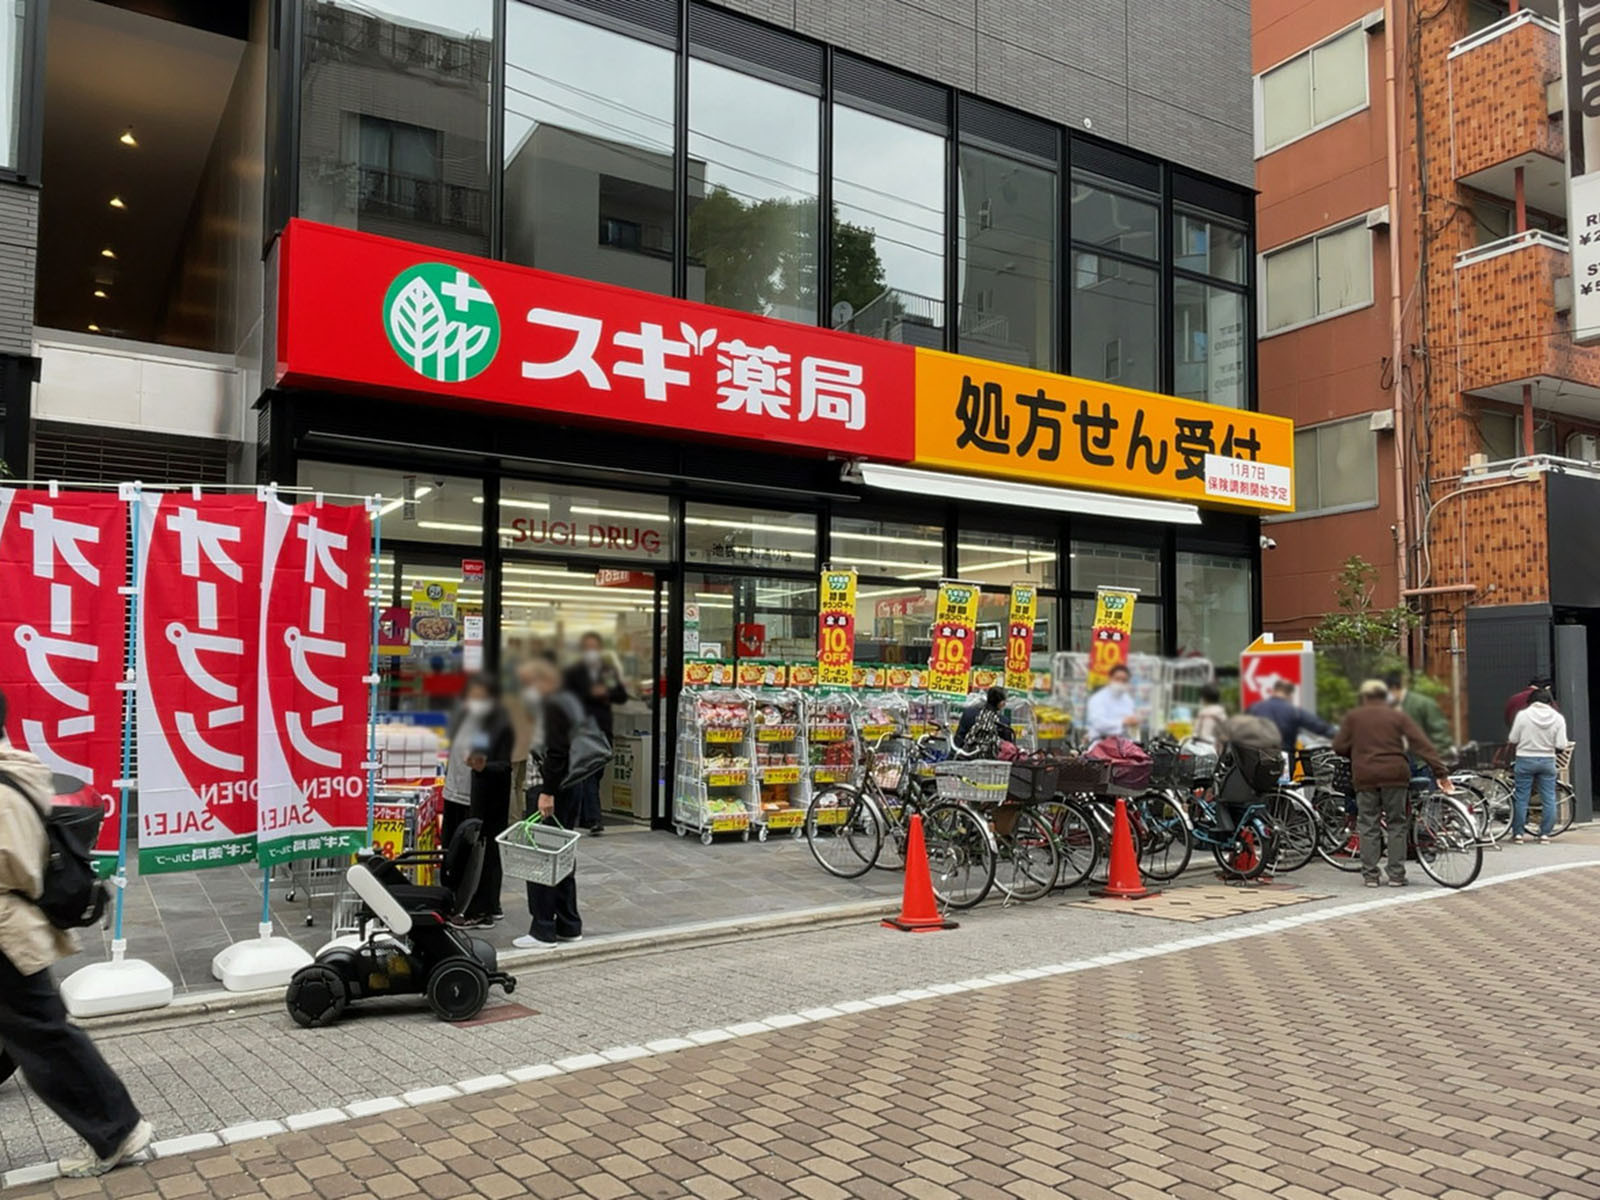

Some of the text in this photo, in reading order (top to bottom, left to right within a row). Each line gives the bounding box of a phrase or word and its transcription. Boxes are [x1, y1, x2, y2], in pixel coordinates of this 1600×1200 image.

[1586, 214, 1600, 227] R
[521, 307, 866, 431] スギ薬局
[1230, 462, 1266, 481] 11月7日
[1208, 475, 1289, 501] 保険調剤開始予定
[511, 517, 661, 553] SUGI DRUG
[823, 652, 848, 663] OFF
[823, 668, 848, 676] クーポン
[935, 661, 965, 672] OFF
[821, 675, 850, 684] プレゼント
[935, 676, 963, 685] クーポン
[931, 683, 966, 693] プレゼント
